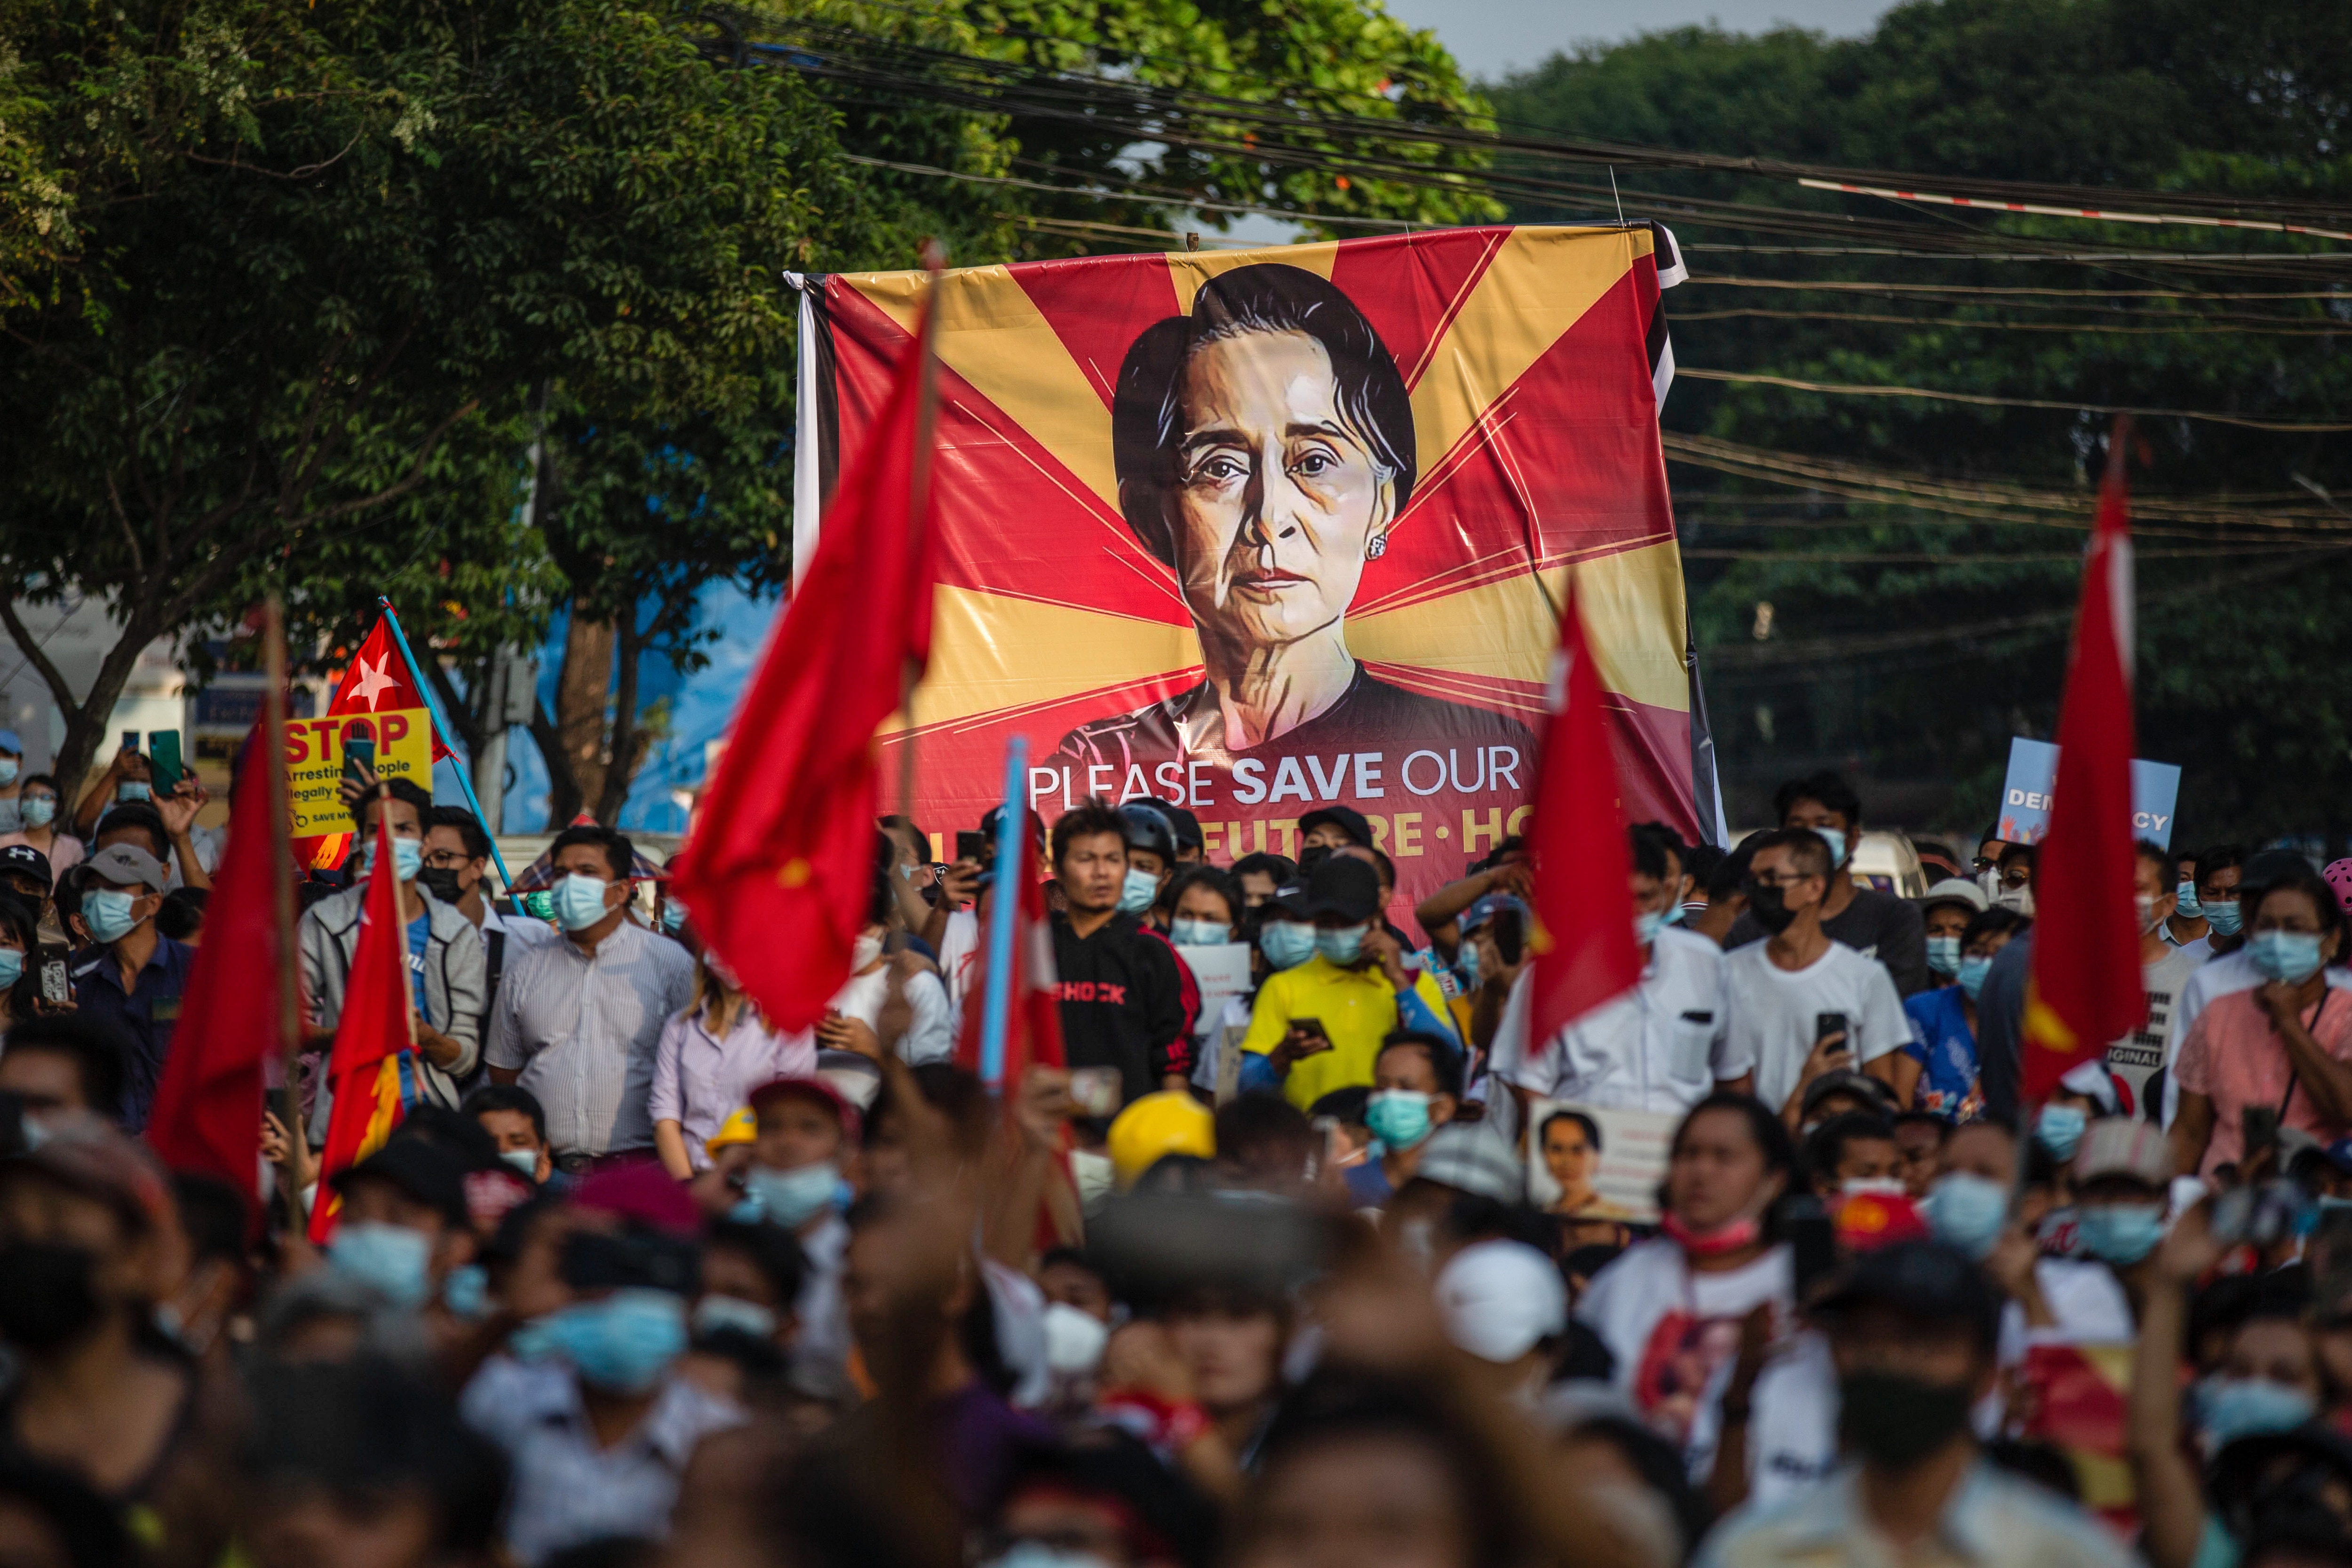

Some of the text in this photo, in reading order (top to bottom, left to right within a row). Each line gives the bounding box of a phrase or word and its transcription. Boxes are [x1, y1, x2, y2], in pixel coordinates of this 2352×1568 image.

[283, 714, 408, 764] STOP
[377, 760, 410, 777] ople
[1029, 746, 1520, 812] PLEASE SAVE OUR
[1201, 812, 1424, 863] FUTRE
[2107, 1048, 2158, 1066] IGINAL
